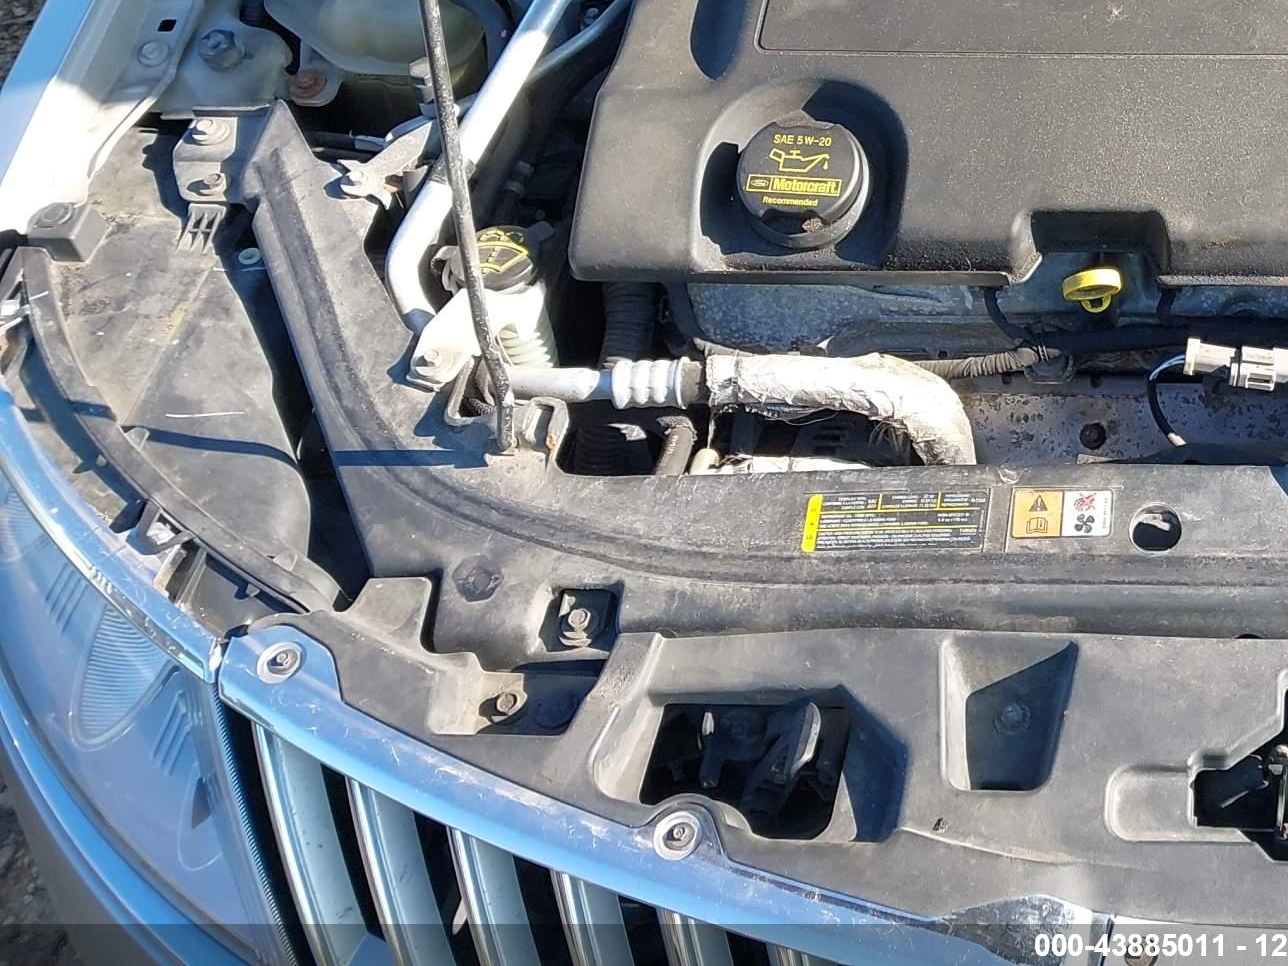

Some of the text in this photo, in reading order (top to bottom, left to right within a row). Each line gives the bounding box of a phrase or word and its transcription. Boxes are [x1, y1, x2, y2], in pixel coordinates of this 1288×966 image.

[774, 134, 832, 147] SAE 5W-20
[773, 178, 836, 193] Motorcraft
[763, 196, 818, 206] Recommended
